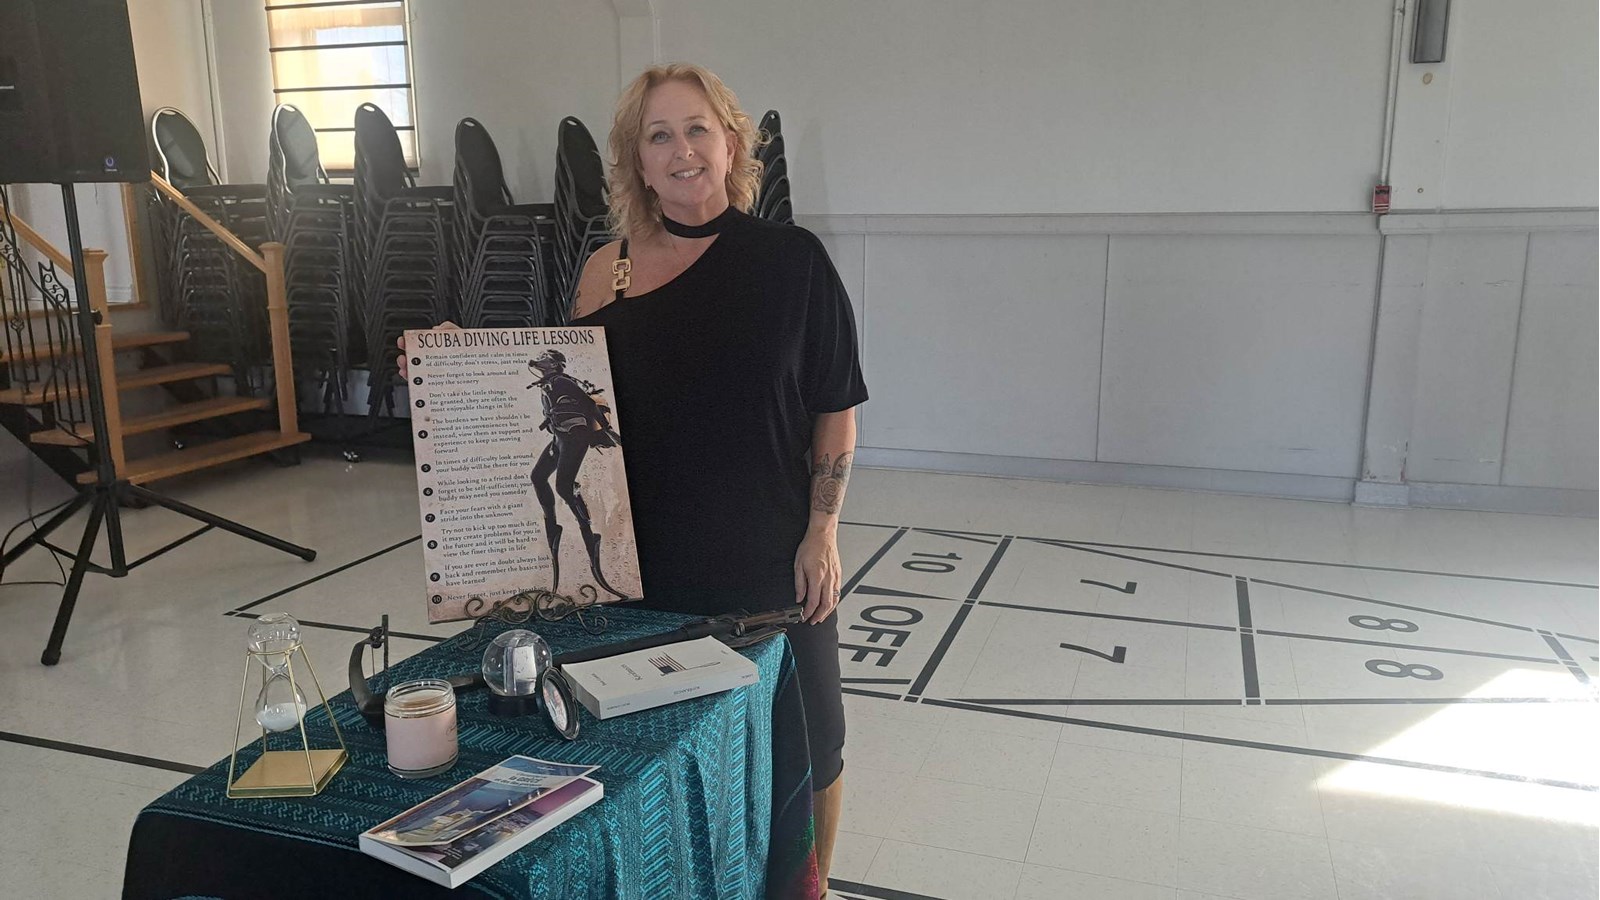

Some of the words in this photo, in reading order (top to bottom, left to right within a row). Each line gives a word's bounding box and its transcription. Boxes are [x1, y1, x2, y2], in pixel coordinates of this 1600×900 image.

[418, 332, 461, 348] SCUBA
[464, 331, 510, 347] DIVING
[512, 331, 540, 346] LIFE
[542, 330, 595, 345] LESSONS
[487, 388, 507, 396] things
[466, 397, 480, 405] they
[446, 405, 475, 413] enjoyable
[476, 404, 496, 412] things
[498, 428, 521, 436] support
[433, 439, 467, 448] experience
[475, 437, 490, 445] keep
[498, 435, 521, 443] moving
[469, 455, 498, 464] difficulty
[450, 464, 470, 473] buddy
[456, 477, 480, 486] looking
[493, 474, 512, 482] friend
[437, 487, 457, 496] forget
[438, 494, 459, 503] buddy
[501, 488, 528, 497] someday
[439, 507, 455, 515] Face
[507, 501, 524, 510] giant
[485, 510, 513, 518] unknown
[441, 527, 453, 536] Try
[507, 520, 525, 528] much
[448, 536, 462, 544] may
[483, 530, 512, 540] problems
[454, 541, 474, 549] future
[515, 535, 530, 543] hard
[443, 550, 459, 558] view
[487, 545, 507, 555] things
[497, 557, 515, 565] doubt
[516, 555, 537, 565] always
[902, 552, 962, 573] 10
[445, 571, 461, 579] back
[474, 566, 506, 576] remember
[518, 563, 538, 571] basics
[445, 579, 461, 587] have
[462, 576, 486, 585] learned
[1080, 578, 1137, 595] 7
[446, 593, 466, 601] Never
[489, 589, 502, 598] just
[502, 587, 517, 597] keep
[1348, 614, 1420, 634] 8
[838, 605, 924, 667] OFF
[1060, 642, 1127, 664] 7
[1365, 658, 1444, 681] 8
